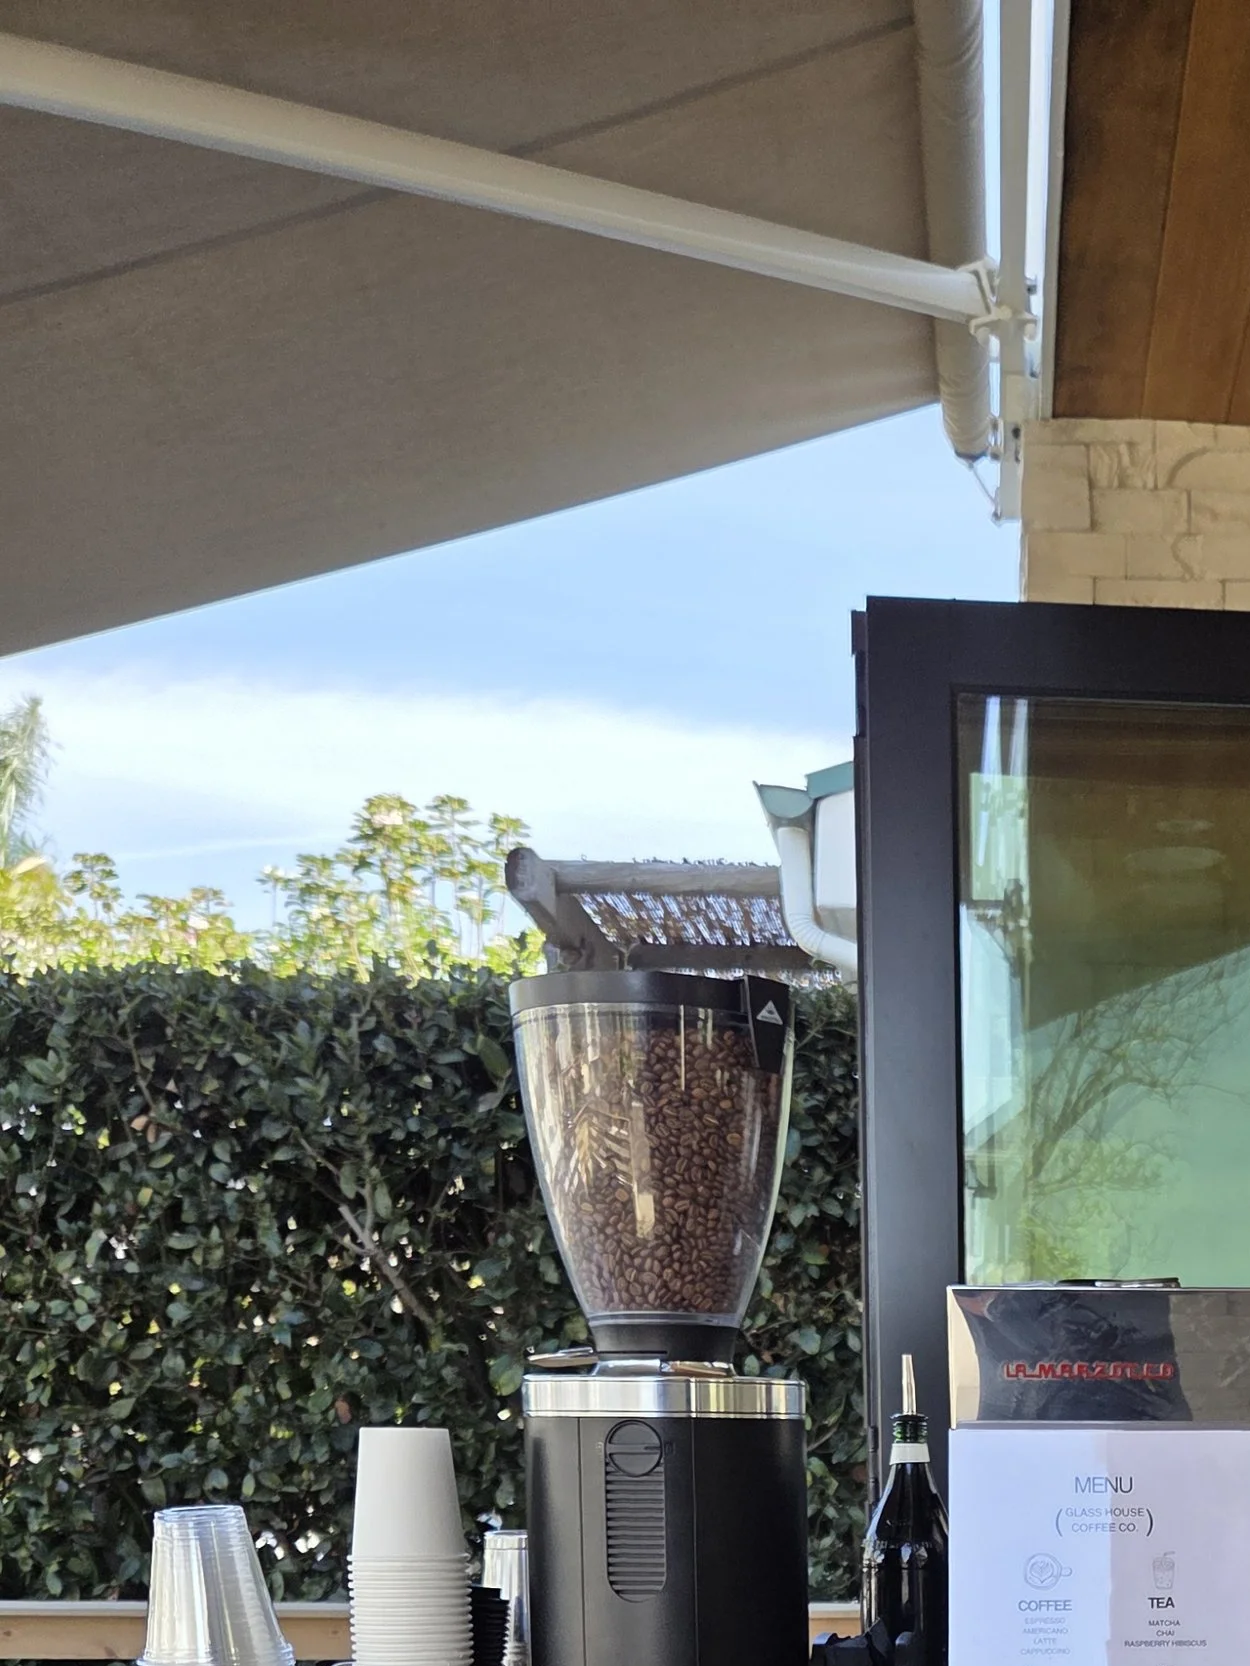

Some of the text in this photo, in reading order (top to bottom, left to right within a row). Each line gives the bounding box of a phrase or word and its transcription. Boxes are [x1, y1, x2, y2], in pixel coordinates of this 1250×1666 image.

[1074, 1476, 1133, 1494] MENU
[1065, 1507, 1145, 1517] GLASS HOUSE
[1071, 1522, 1139, 1533] COFFEE CO.
[1018, 1600, 1073, 1612] COFFEE
[1148, 1597, 1175, 1609] TEA
[1124, 1640, 1170, 1648] RASPBERRY
